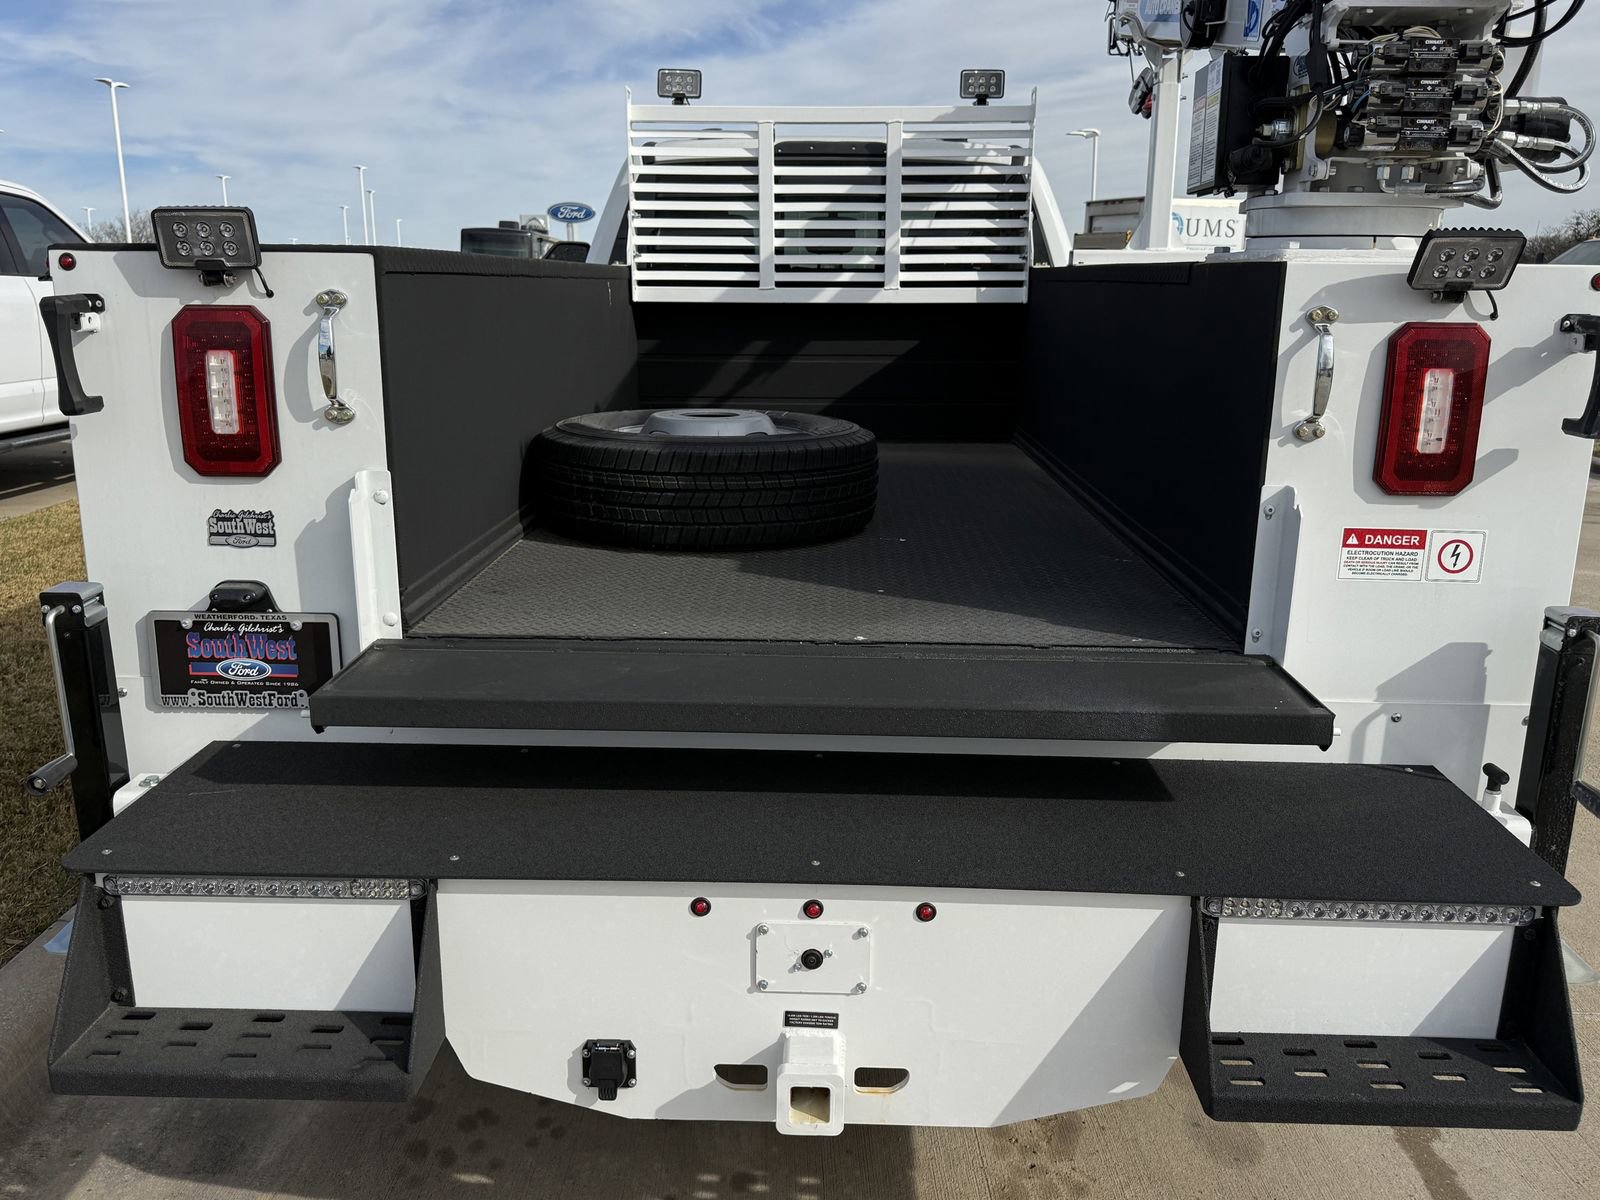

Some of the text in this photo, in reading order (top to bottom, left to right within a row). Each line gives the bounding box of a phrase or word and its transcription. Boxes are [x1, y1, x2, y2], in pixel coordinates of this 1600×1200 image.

[557, 205, 586, 219] Ford
[1186, 218, 1236, 238] UMS
[209, 517, 274, 534] SouthWest
[232, 536, 252, 545] Ford
[1364, 534, 1420, 546] DANGER
[204, 622, 285, 636] Charlie Gilchrist's
[186, 632, 298, 660] SouthWest
[228, 661, 259, 677] Ford
